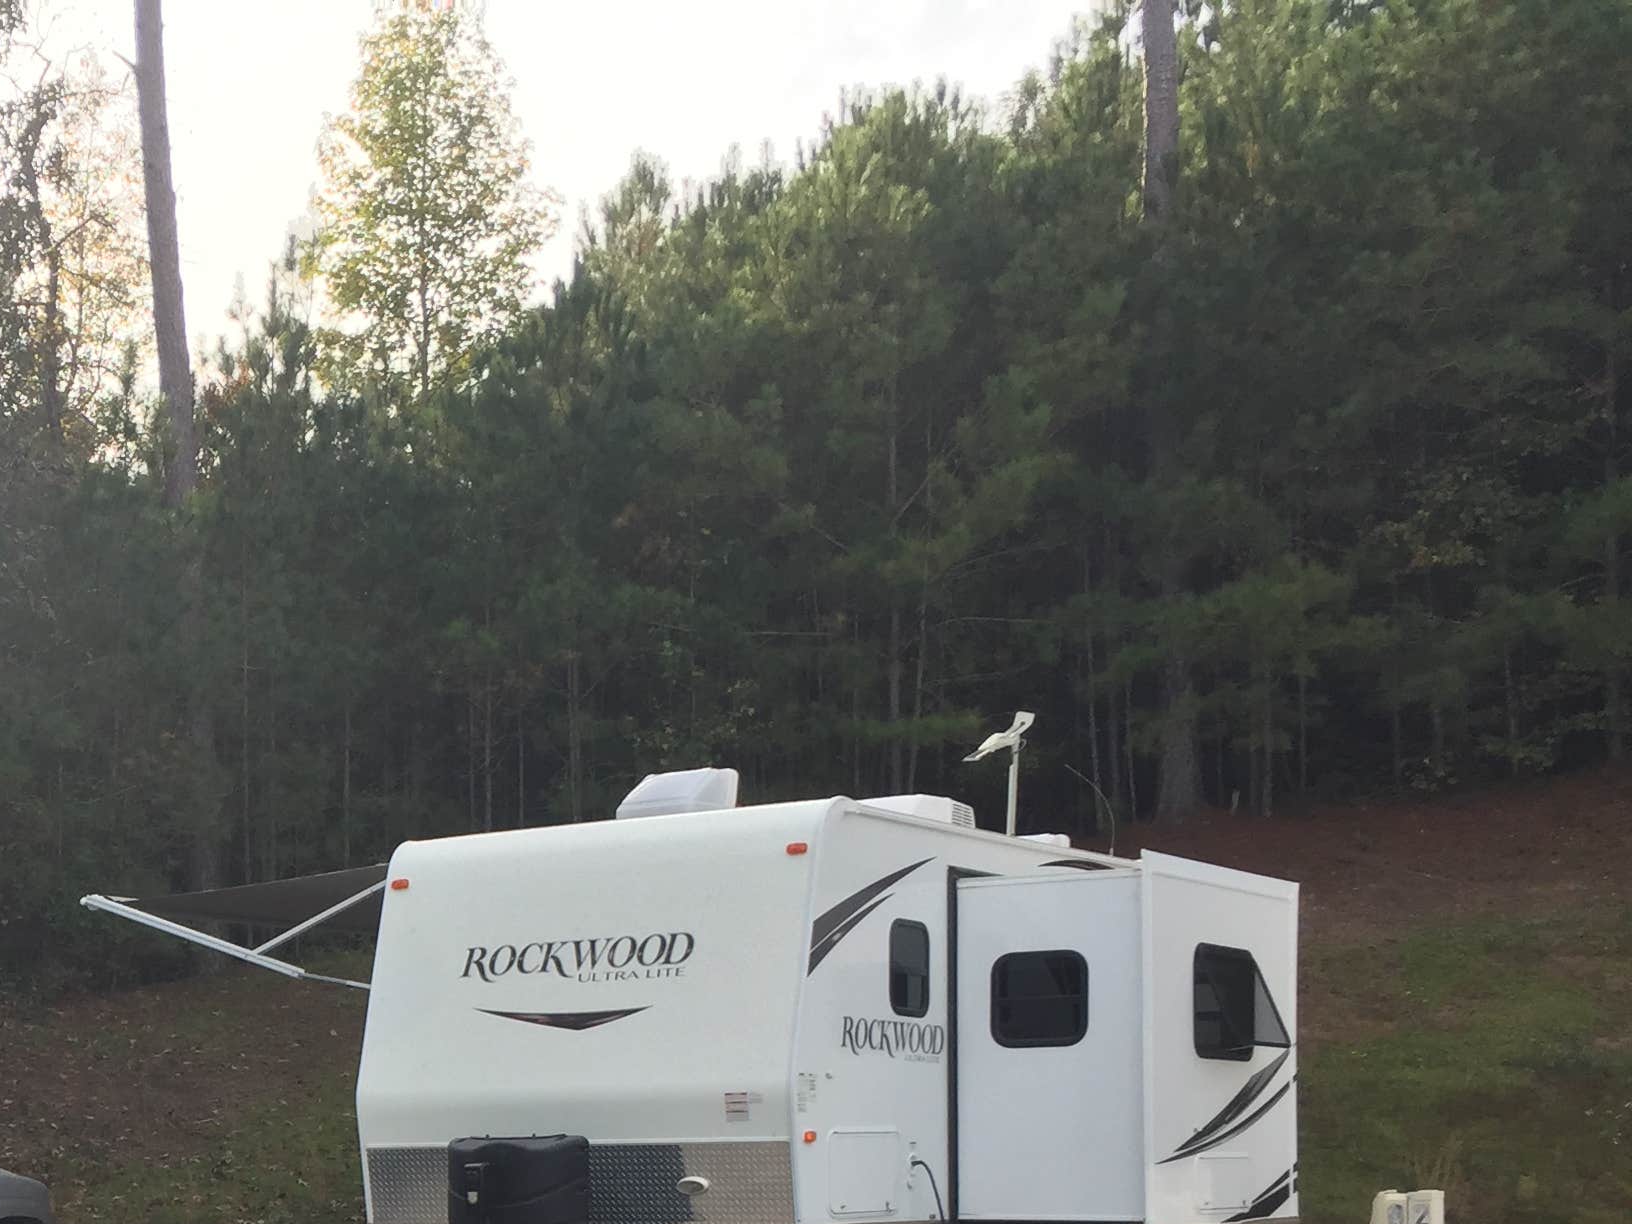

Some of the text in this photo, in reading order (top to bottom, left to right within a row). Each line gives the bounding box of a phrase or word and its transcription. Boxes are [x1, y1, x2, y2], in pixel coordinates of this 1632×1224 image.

[459, 931, 695, 984] ROCKWOOD
[577, 966, 687, 984] ULTRA LITE
[841, 1015, 945, 1058] ROCKWOOD
